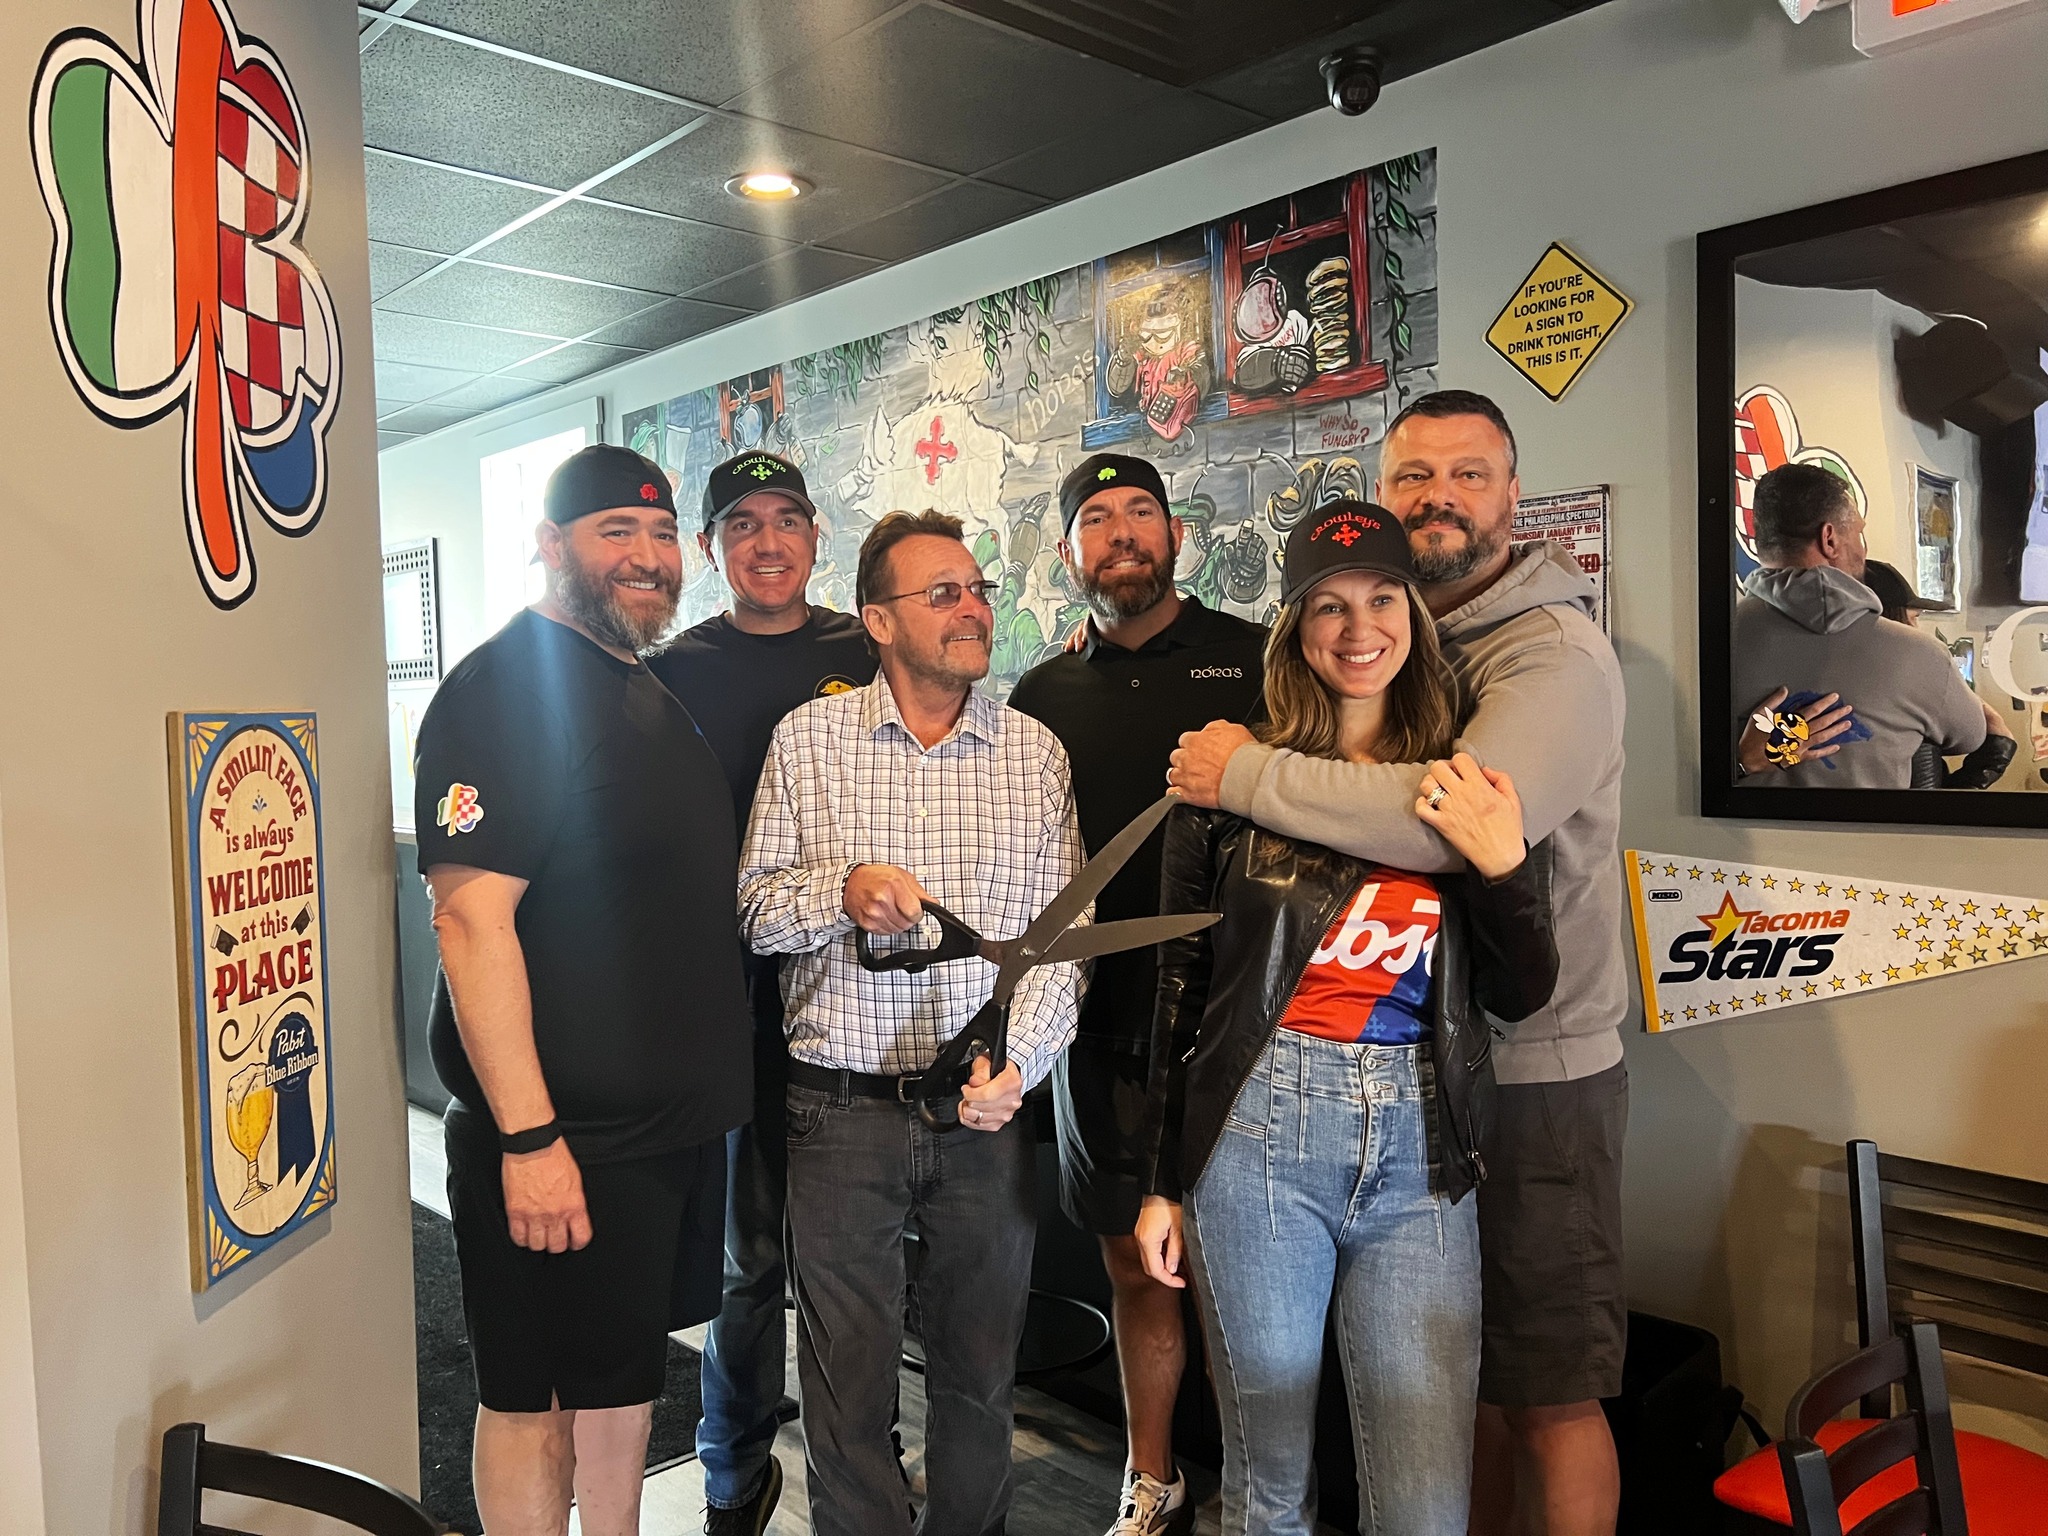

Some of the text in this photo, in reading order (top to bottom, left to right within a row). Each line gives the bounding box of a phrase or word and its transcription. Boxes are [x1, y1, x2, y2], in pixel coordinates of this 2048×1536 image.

[1525, 274, 1583, 298] IF YOU'RE
[1514, 290, 1595, 318] LOOKING FOR
[1525, 310, 1584, 334] A SIGN TO
[1508, 325, 1602, 355] DRINK TONIGHT,
[1525, 347, 1583, 369] THIS IS IT.
[1319, 414, 1341, 430] WHY
[1322, 427, 1370, 449] FUNGRY?
[1524, 512, 1565, 527] PHILADELPHIA
[1566, 508, 1600, 522] SPECTRUM
[1511, 530, 1545, 542] THURSDAY
[1546, 526, 1575, 538] JANUARY
[209, 743, 307, 833] A SMILIN' FACE
[226, 818, 295, 861] is always
[207, 856, 314, 917] WELCOME
[241, 909, 288, 944] at this
[1740, 908, 1851, 935] Tacoma
[1658, 930, 1845, 984] Stars
[212, 939, 313, 1014] PLACE
[275, 1027, 306, 1057] Pabst
[266, 1052, 318, 1085] Blue Ribbon
